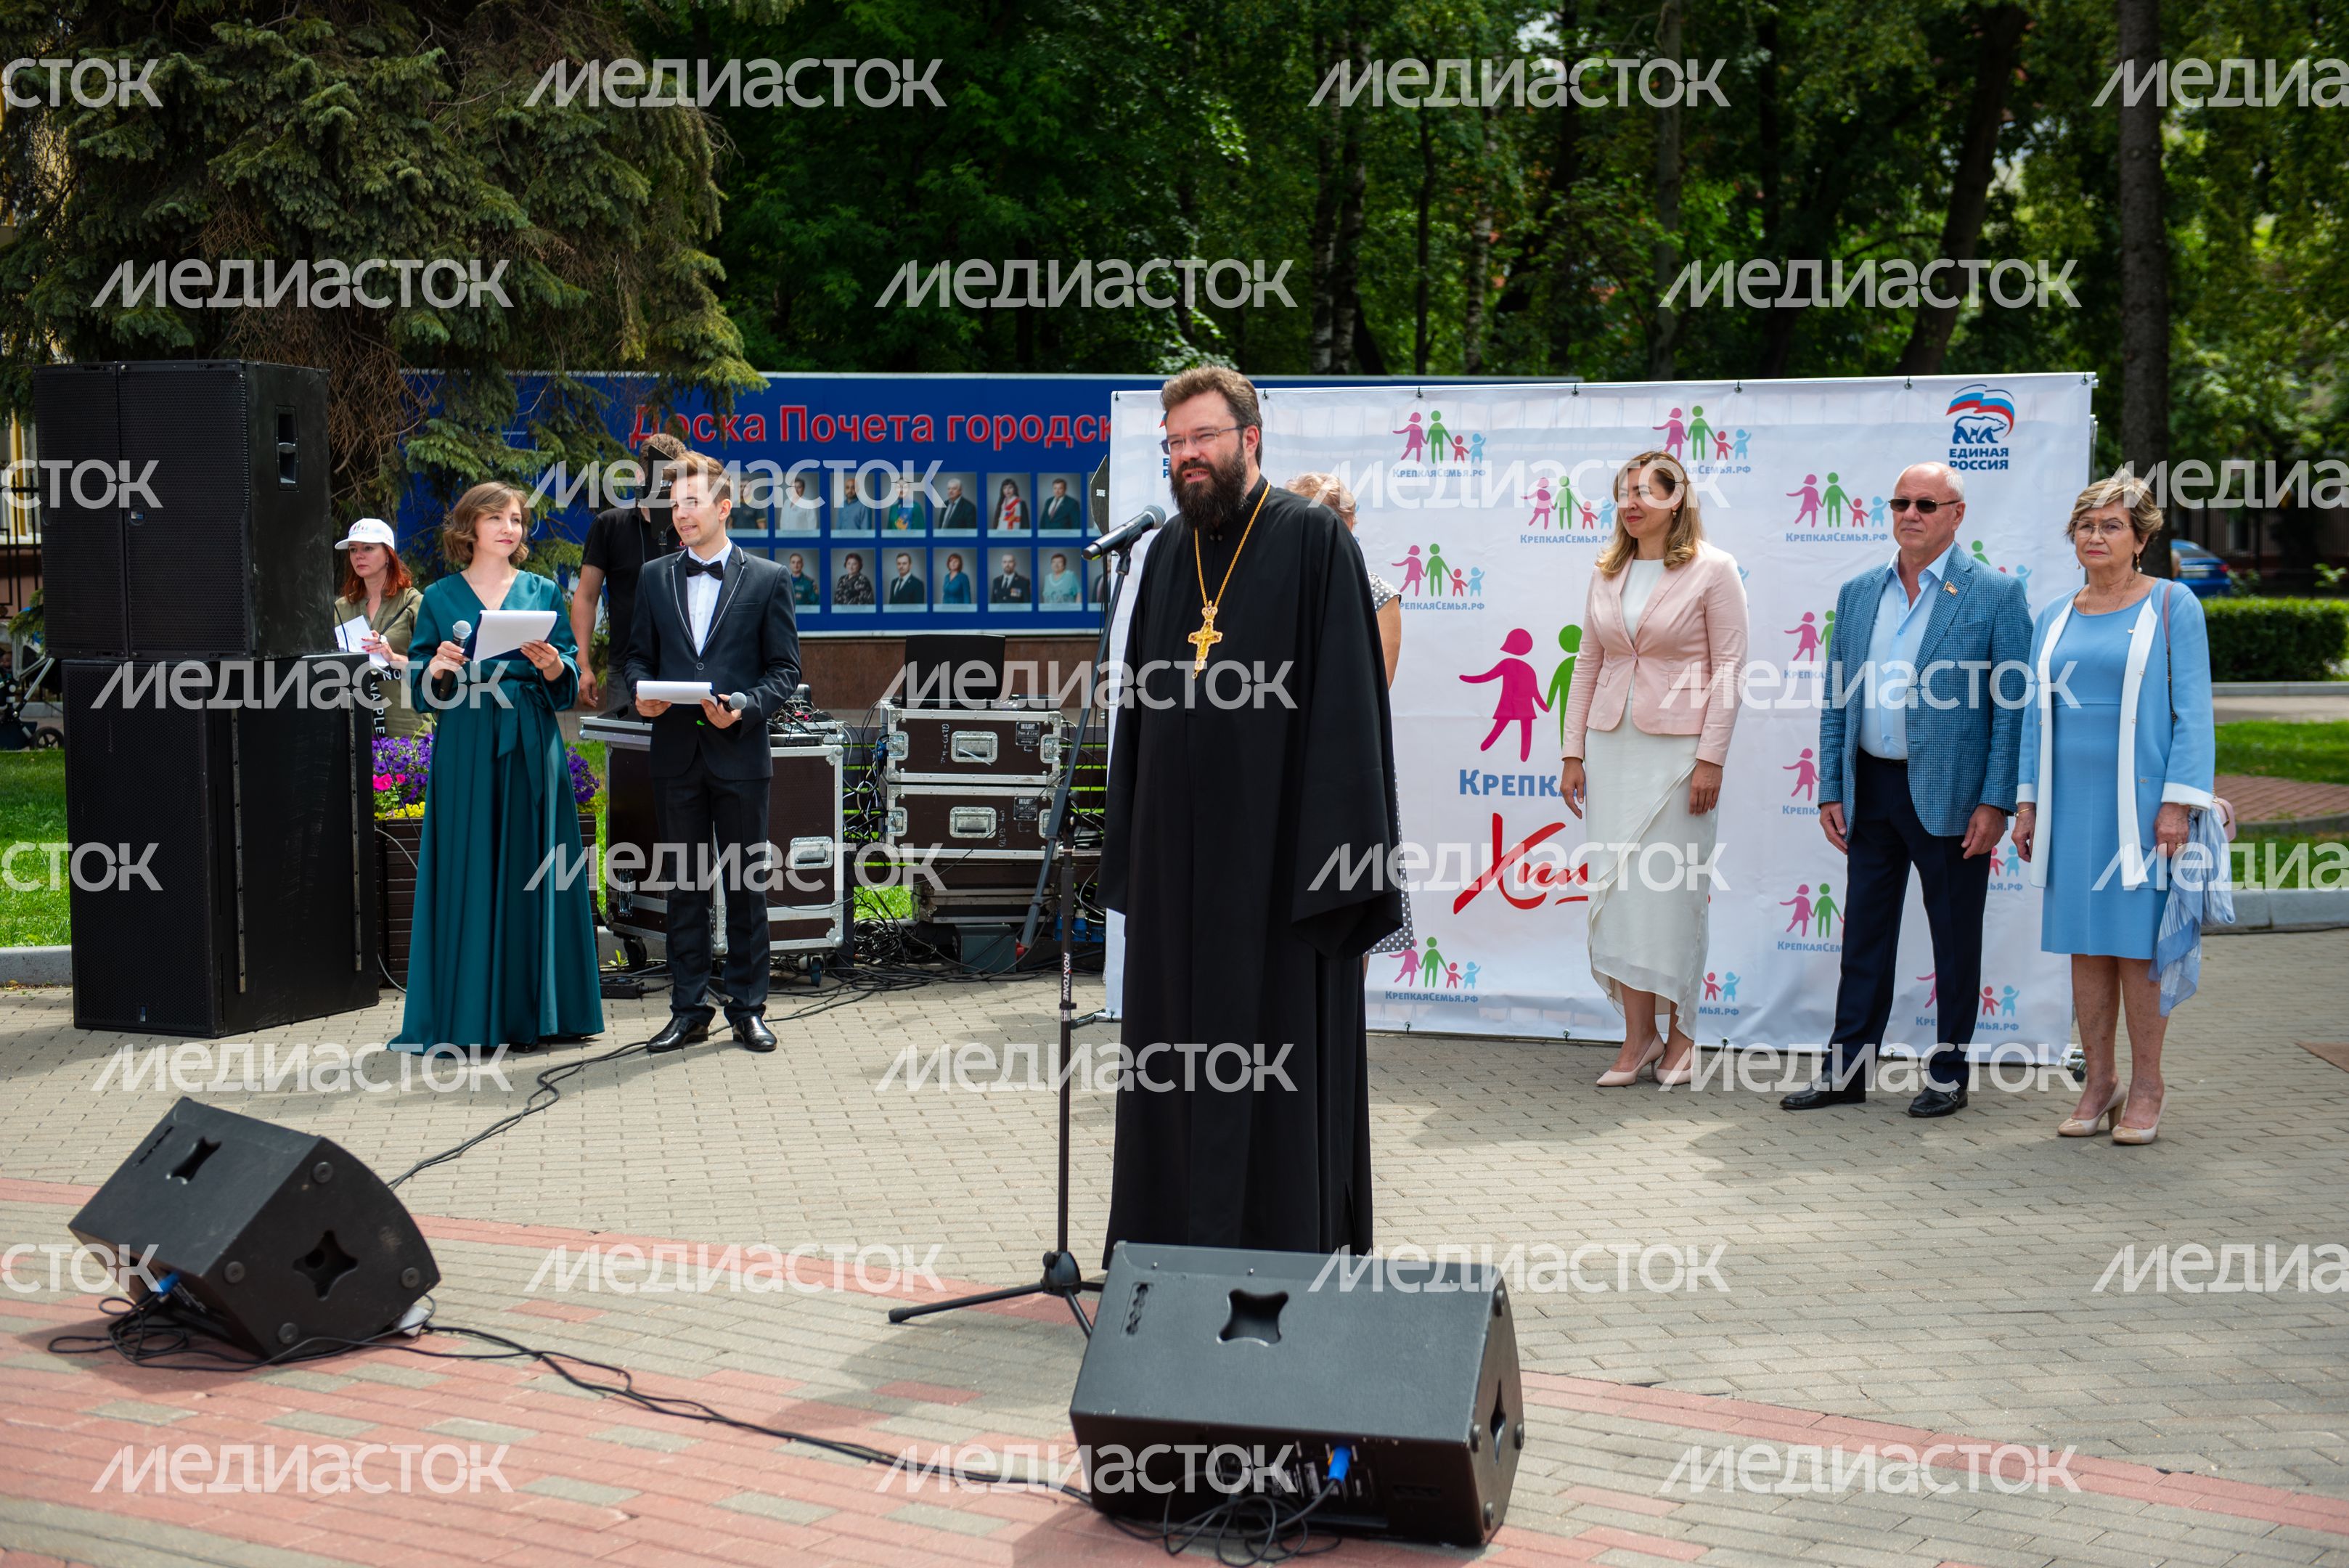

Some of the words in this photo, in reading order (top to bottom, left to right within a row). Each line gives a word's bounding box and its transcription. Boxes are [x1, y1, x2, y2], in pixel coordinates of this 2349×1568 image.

[780, 404, 934, 443] Почета
[1949, 447, 2009, 459] ЕДИНАЯ
[1949, 460, 2009, 470] РОССИЯ
[1063, 952, 1071, 1001] ROXTONE
